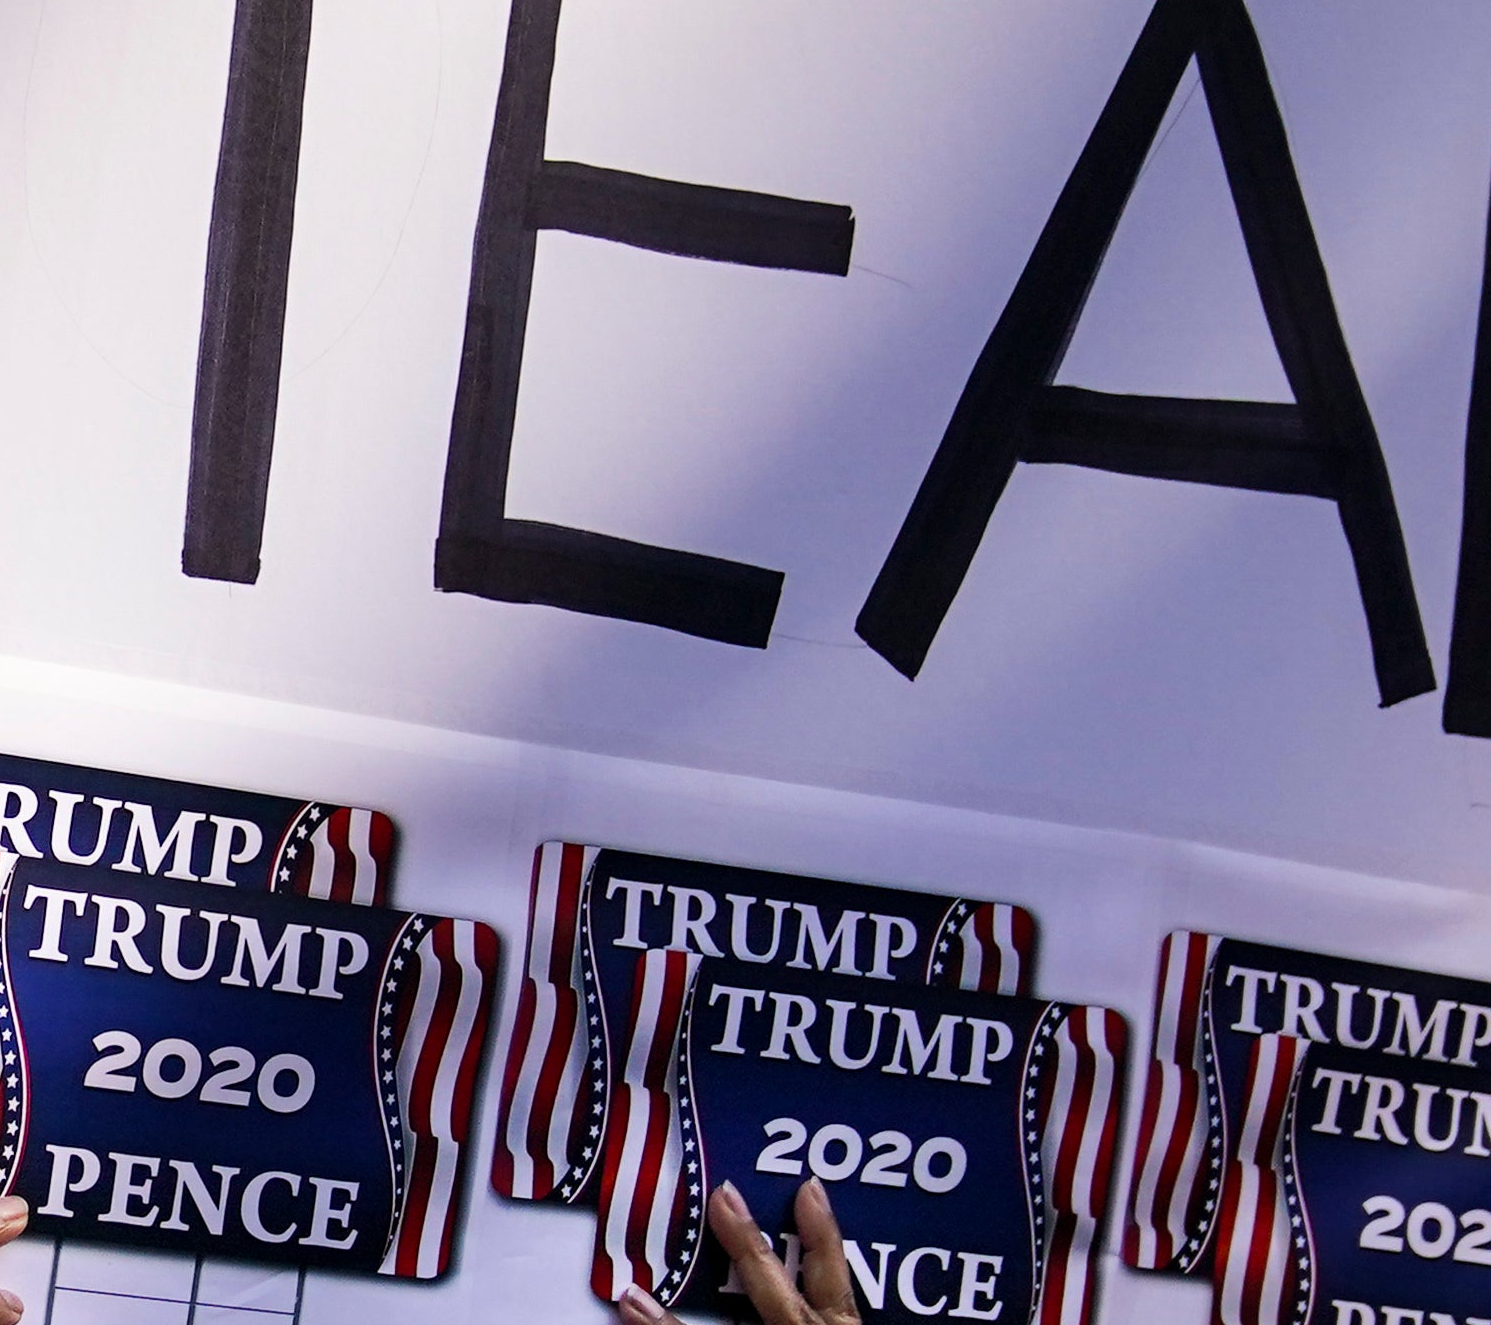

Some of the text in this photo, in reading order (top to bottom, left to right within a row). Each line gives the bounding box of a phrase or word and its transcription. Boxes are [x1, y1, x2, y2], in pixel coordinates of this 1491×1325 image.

[22, 885, 370, 1001] TRUMP
[605, 876, 919, 982] TRUMP
[83, 1029, 317, 1115] 2020
[708, 983, 1014, 1086] TRUMP
[36, 1144, 362, 1252] PENCE
[754, 1116, 968, 1194] 2020
